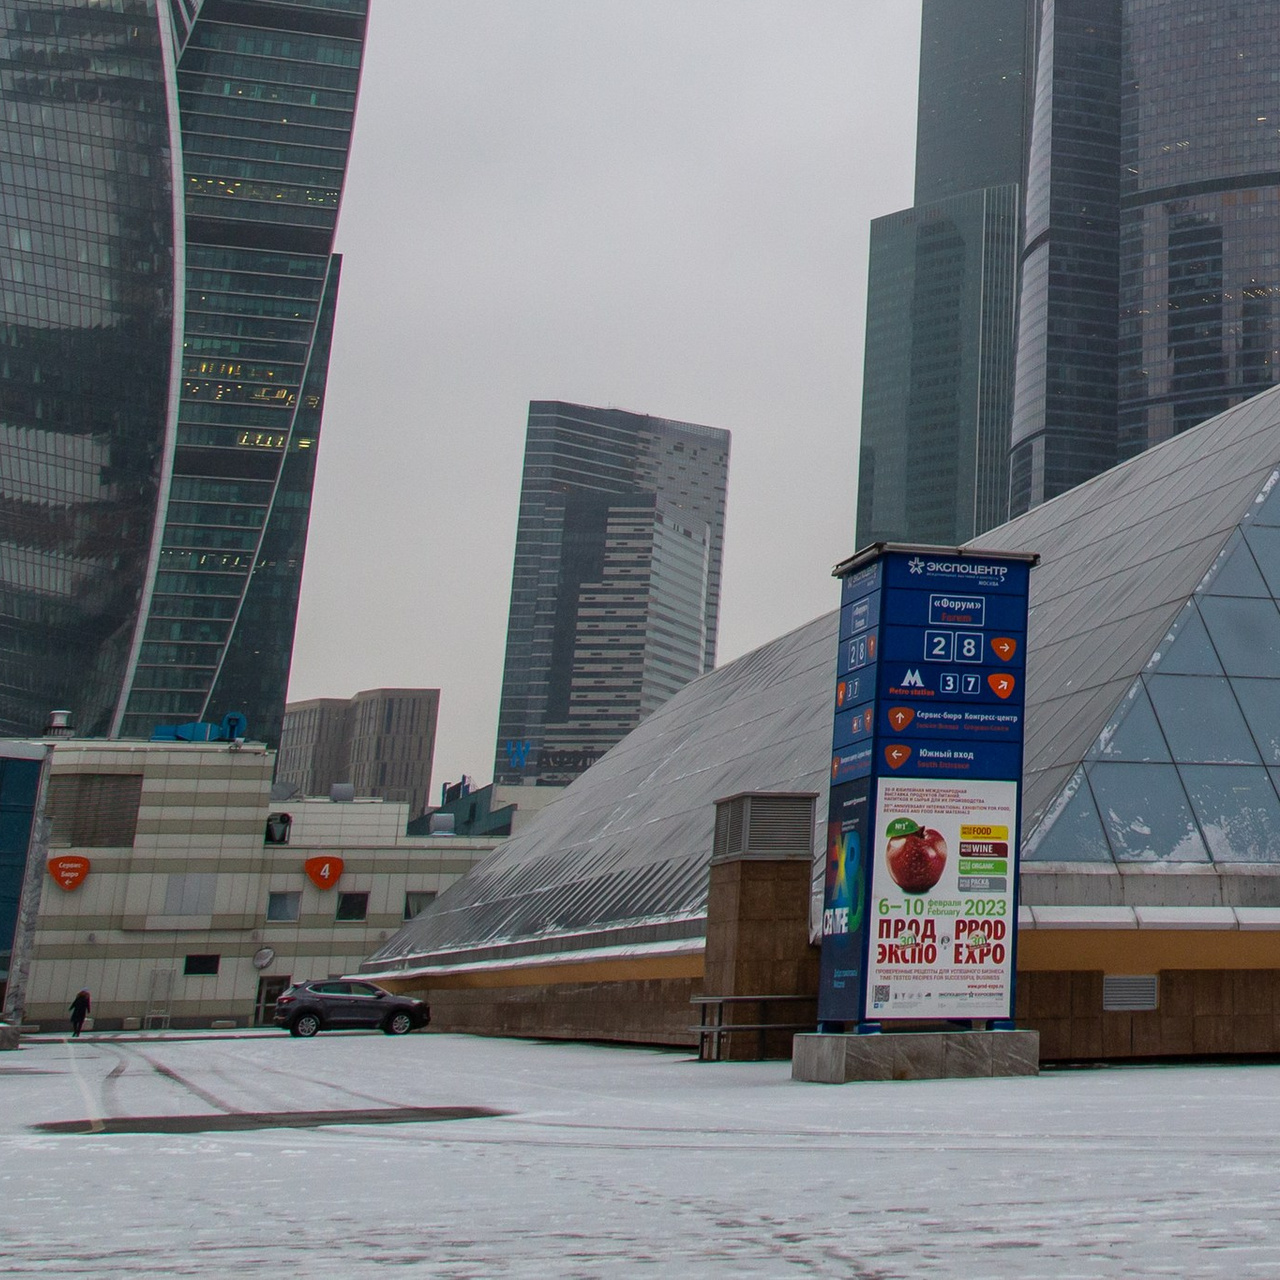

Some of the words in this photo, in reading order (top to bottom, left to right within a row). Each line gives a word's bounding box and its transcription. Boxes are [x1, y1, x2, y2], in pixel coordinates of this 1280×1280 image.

[926, 562, 1008, 575] ЭКСПОЦЕНТР
[934, 598, 981, 611] «Форум»
[932, 637, 946, 655] 2
[962, 639, 976, 657] 8
[945, 676, 954, 691] 3
[966, 677, 976, 691] 7
[920, 748, 952, 758] Южный
[953, 751, 974, 760] вход
[972, 827, 992, 835] FOOD
[972, 844, 994, 853] WINE
[320, 864, 330, 879] 4
[927, 907, 961, 918] February
[964, 899, 1007, 916] 2023
[878, 919, 937, 943] ПРОД
[954, 919, 1006, 940] PROD
[877, 943, 937, 965] ЭКСПО
[954, 943, 1005, 965] EXPO
